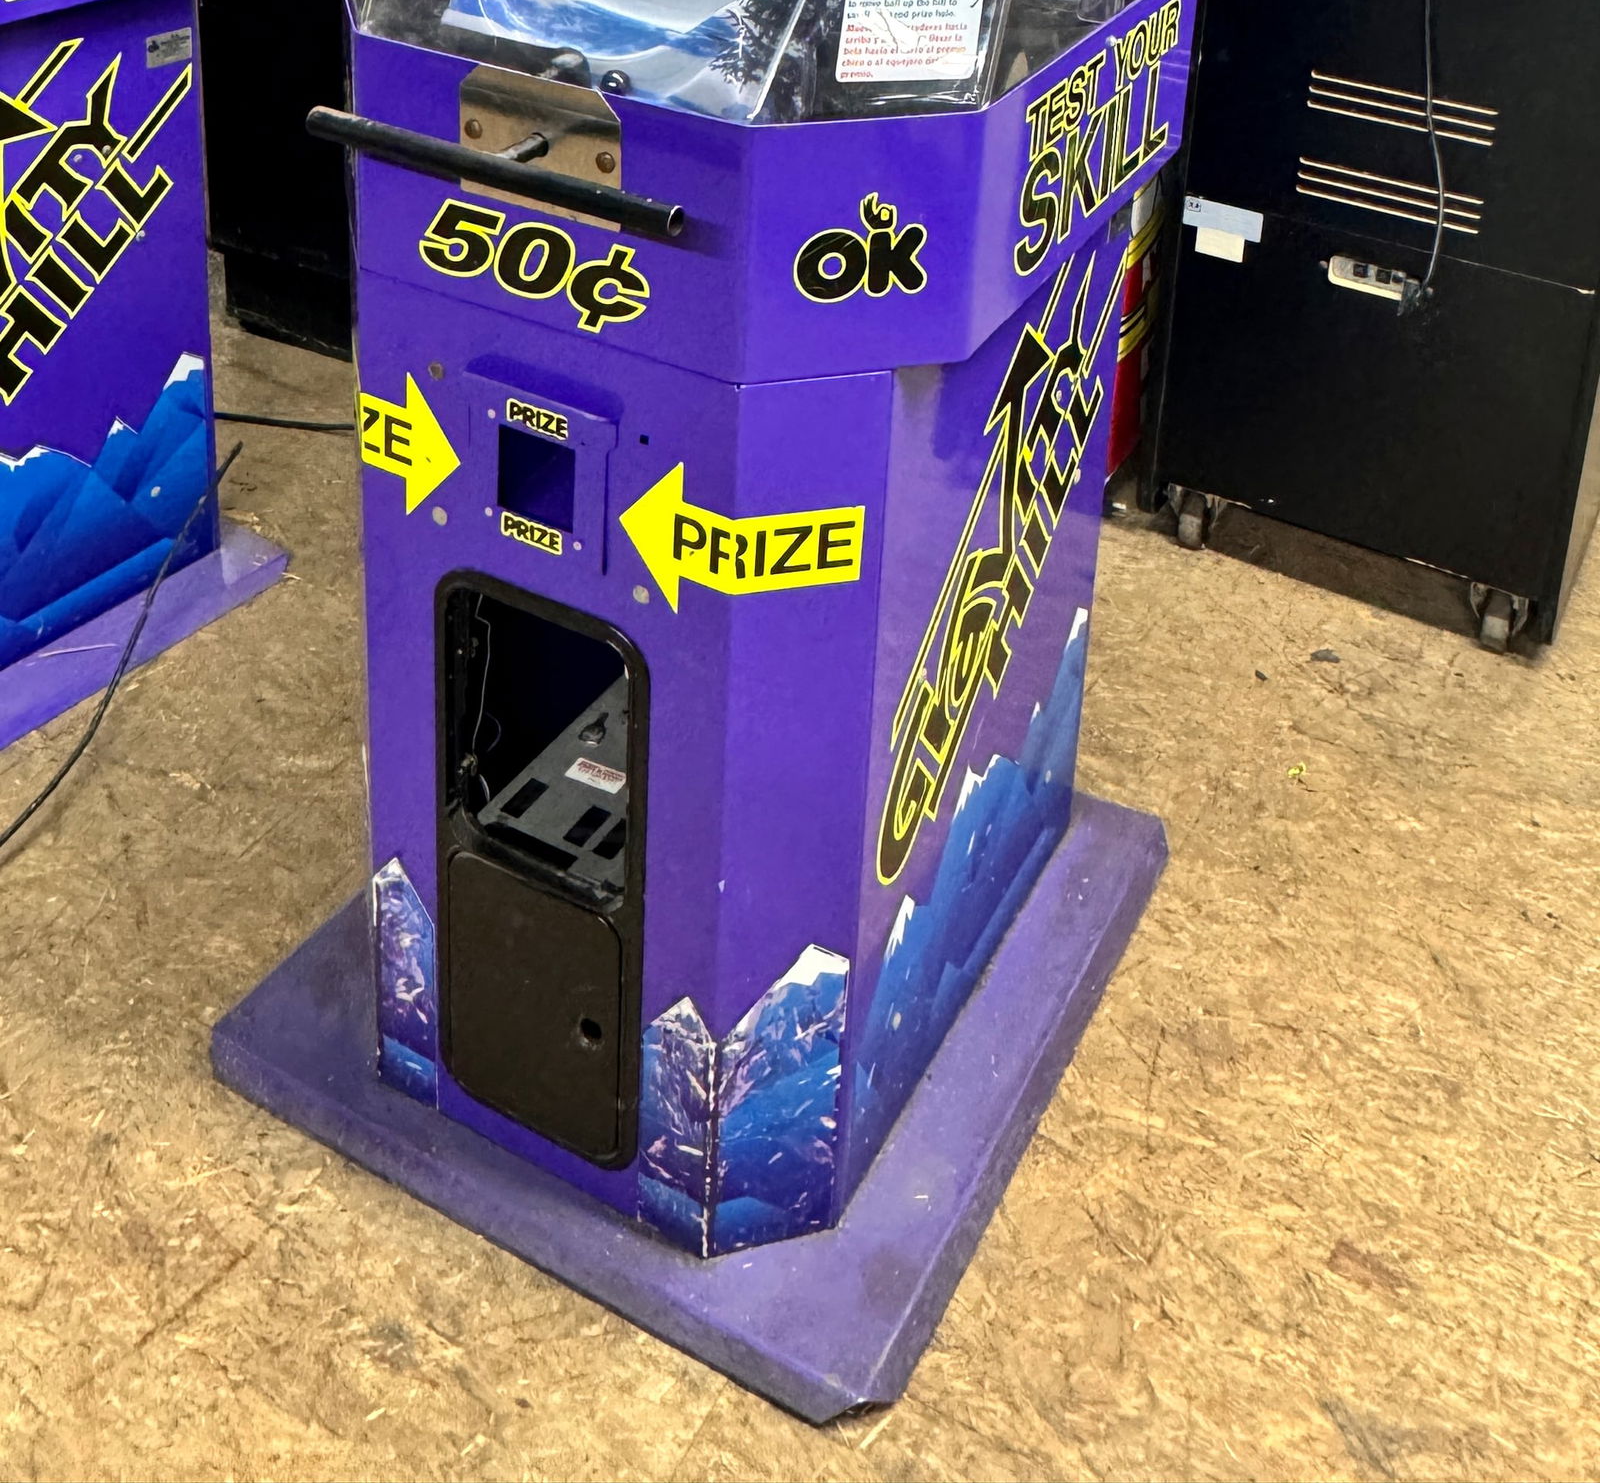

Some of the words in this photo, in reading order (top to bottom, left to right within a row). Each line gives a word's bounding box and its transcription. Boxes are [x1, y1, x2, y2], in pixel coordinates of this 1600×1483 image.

[848, 0, 857, 8] to
[884, 0, 900, 7] ball
[902, 0, 914, 8] up
[916, 0, 930, 7] the
[911, 10, 933, 20] prize
[1026, 49, 1106, 162] TEST
[1014, 61, 1169, 277] SKILL
[418, 198, 651, 334] 50¢
[793, 208, 928, 304] OK
[507, 400, 569, 439] PRIZE
[502, 512, 563, 555] PRIZE
[672, 513, 856, 580] PRIZE
